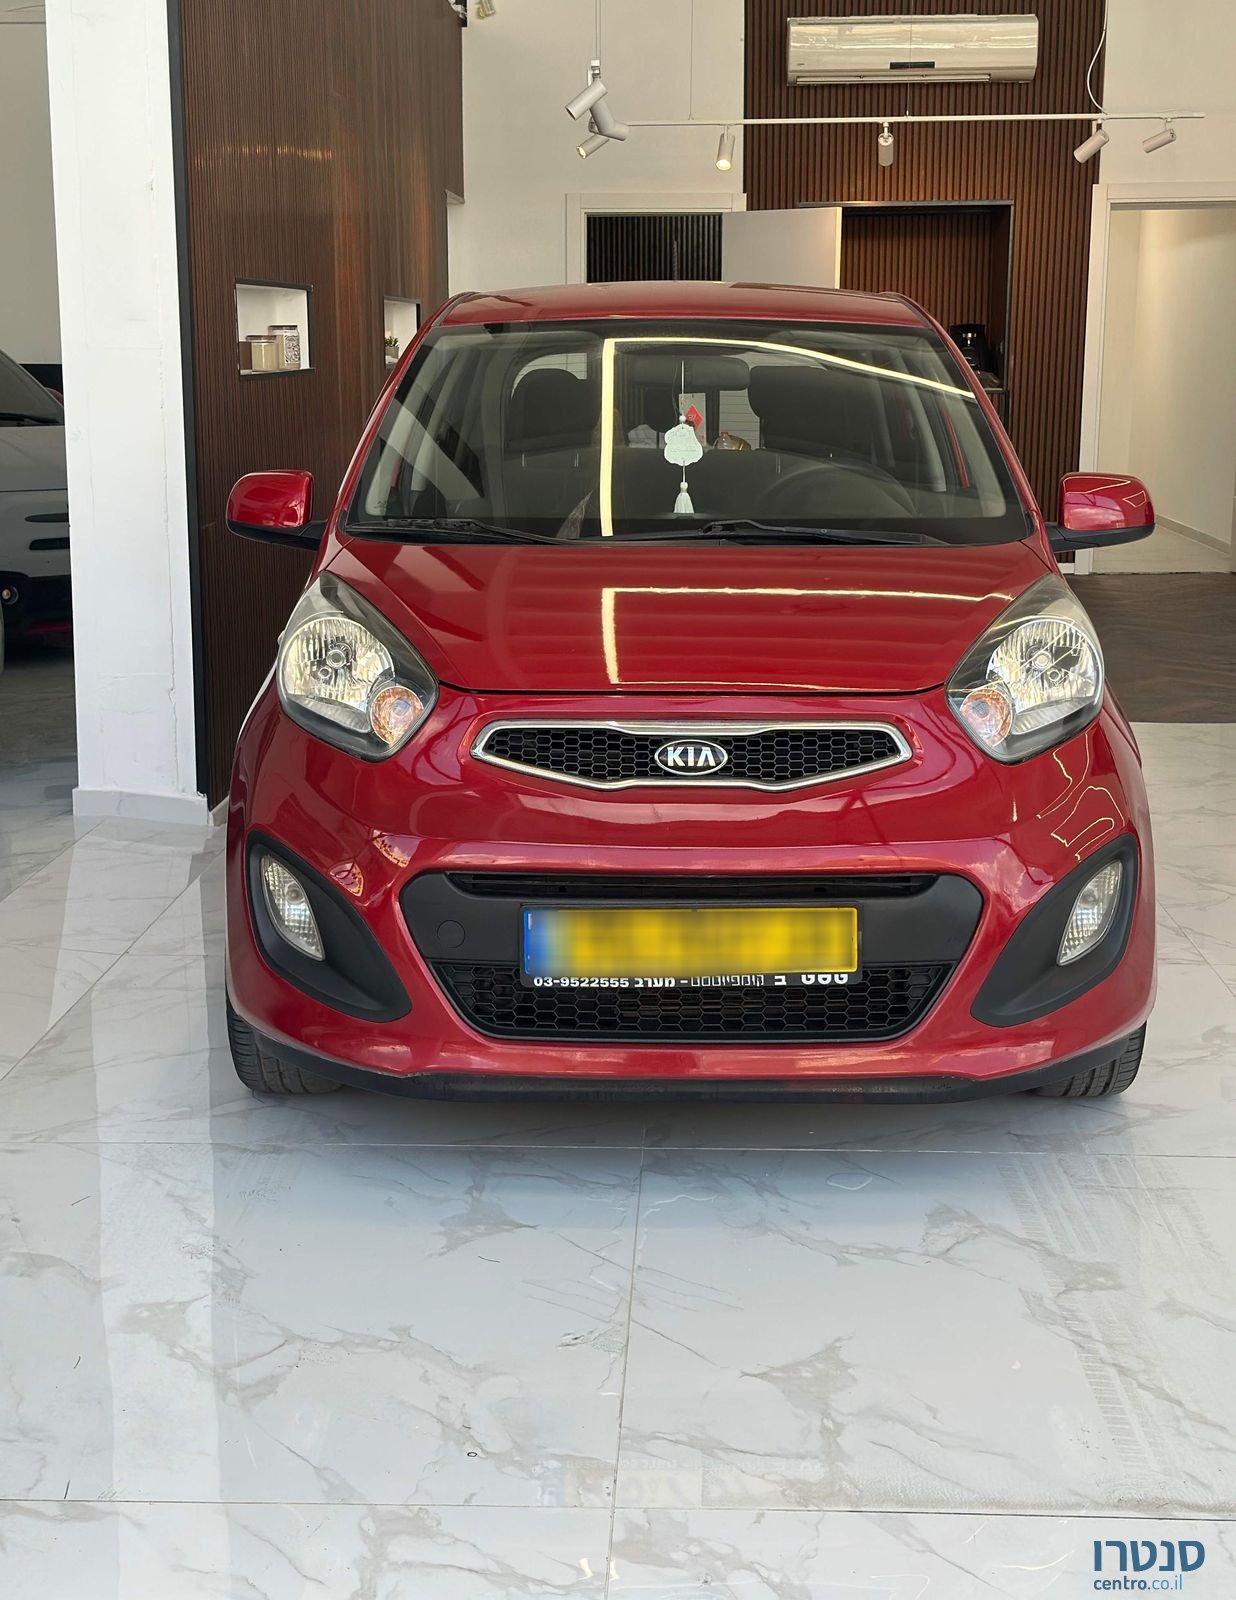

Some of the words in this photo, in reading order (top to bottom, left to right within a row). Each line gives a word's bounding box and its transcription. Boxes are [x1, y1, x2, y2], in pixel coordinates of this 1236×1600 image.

[666, 746, 716, 767] KIA
[533, 976, 630, 988] 03-9522555
[634, 977, 676, 988] מערב
